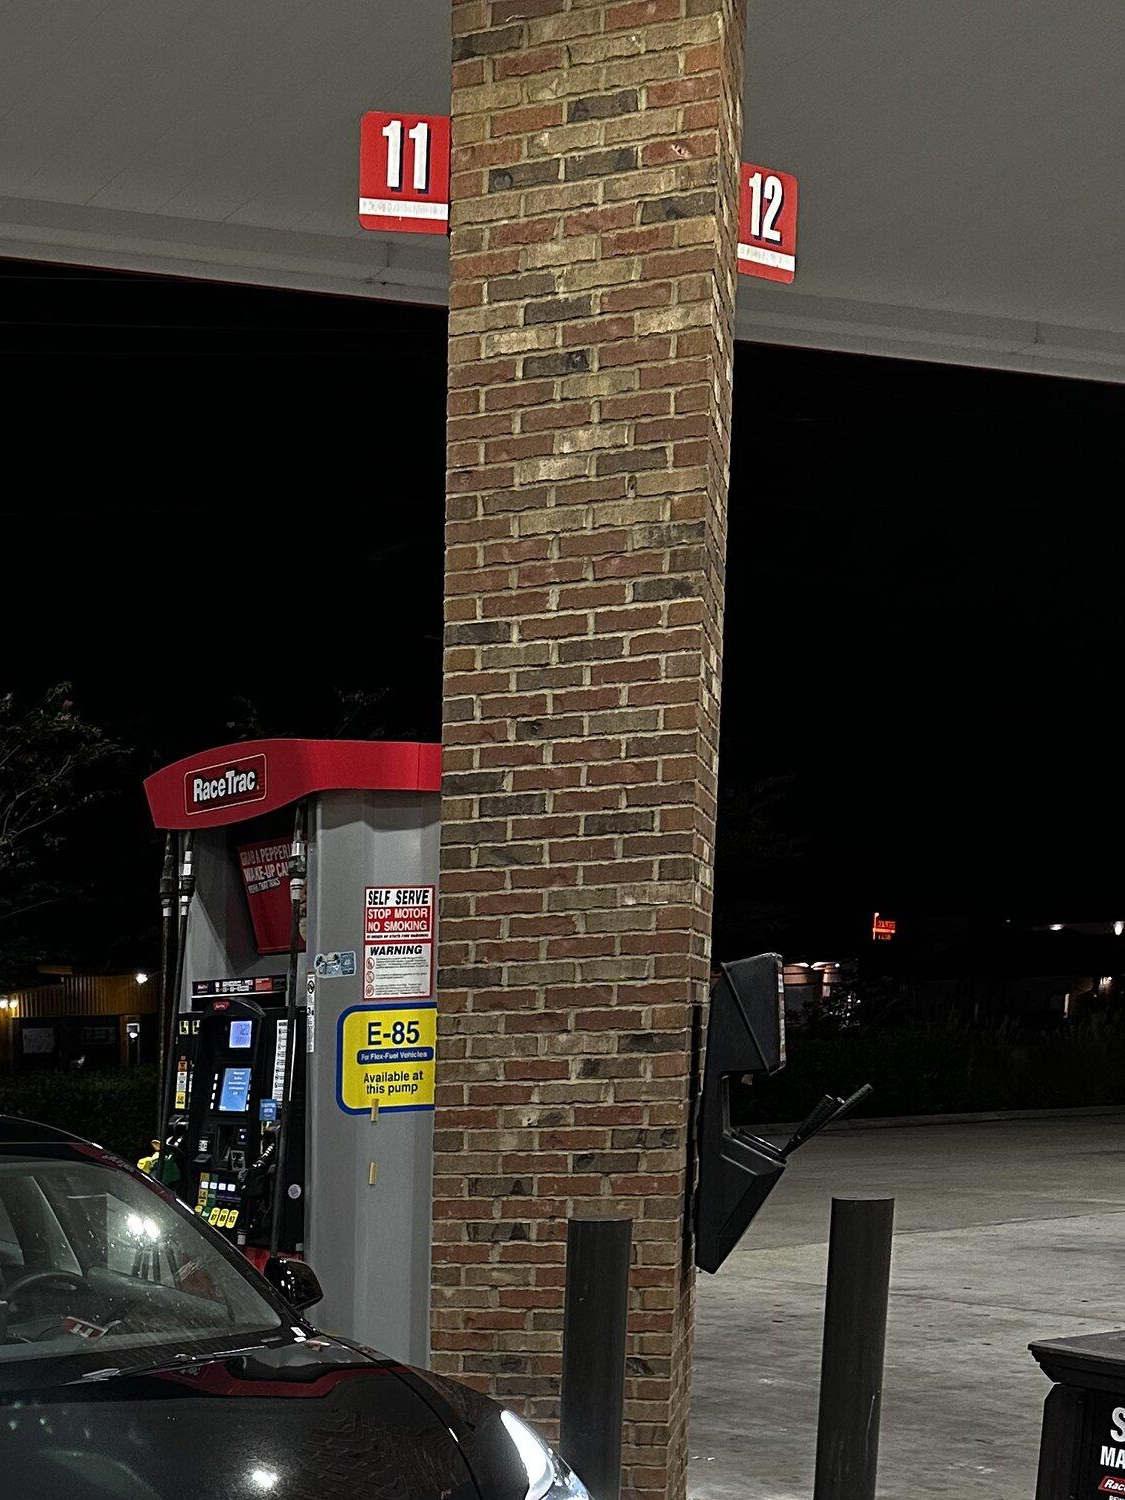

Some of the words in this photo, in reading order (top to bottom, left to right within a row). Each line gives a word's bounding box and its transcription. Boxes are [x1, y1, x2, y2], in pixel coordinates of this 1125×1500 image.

[382, 120, 429, 190] 11
[748, 172, 783, 242] 12
[193, 770, 256, 803] RaceTrac
[368, 890, 391, 906] SELF
[395, 889, 429, 905] SERVE
[368, 908, 392, 920] STOP
[394, 907, 428, 919] MOTOR
[368, 922, 381, 932] NO
[384, 920, 428, 932] SMOKING
[370, 944, 423, 956] WARNING
[367, 1020, 420, 1046] E-85
[361, 1053, 369, 1061] For
[370, 1052, 399, 1061] Flex-Fuel
[400, 1051, 428, 1059] Vehicles
[363, 1071, 410, 1083] Available
[412, 1070, 424, 1081] at
[366, 1083, 385, 1094] this
[388, 1083, 419, 1096] pump
